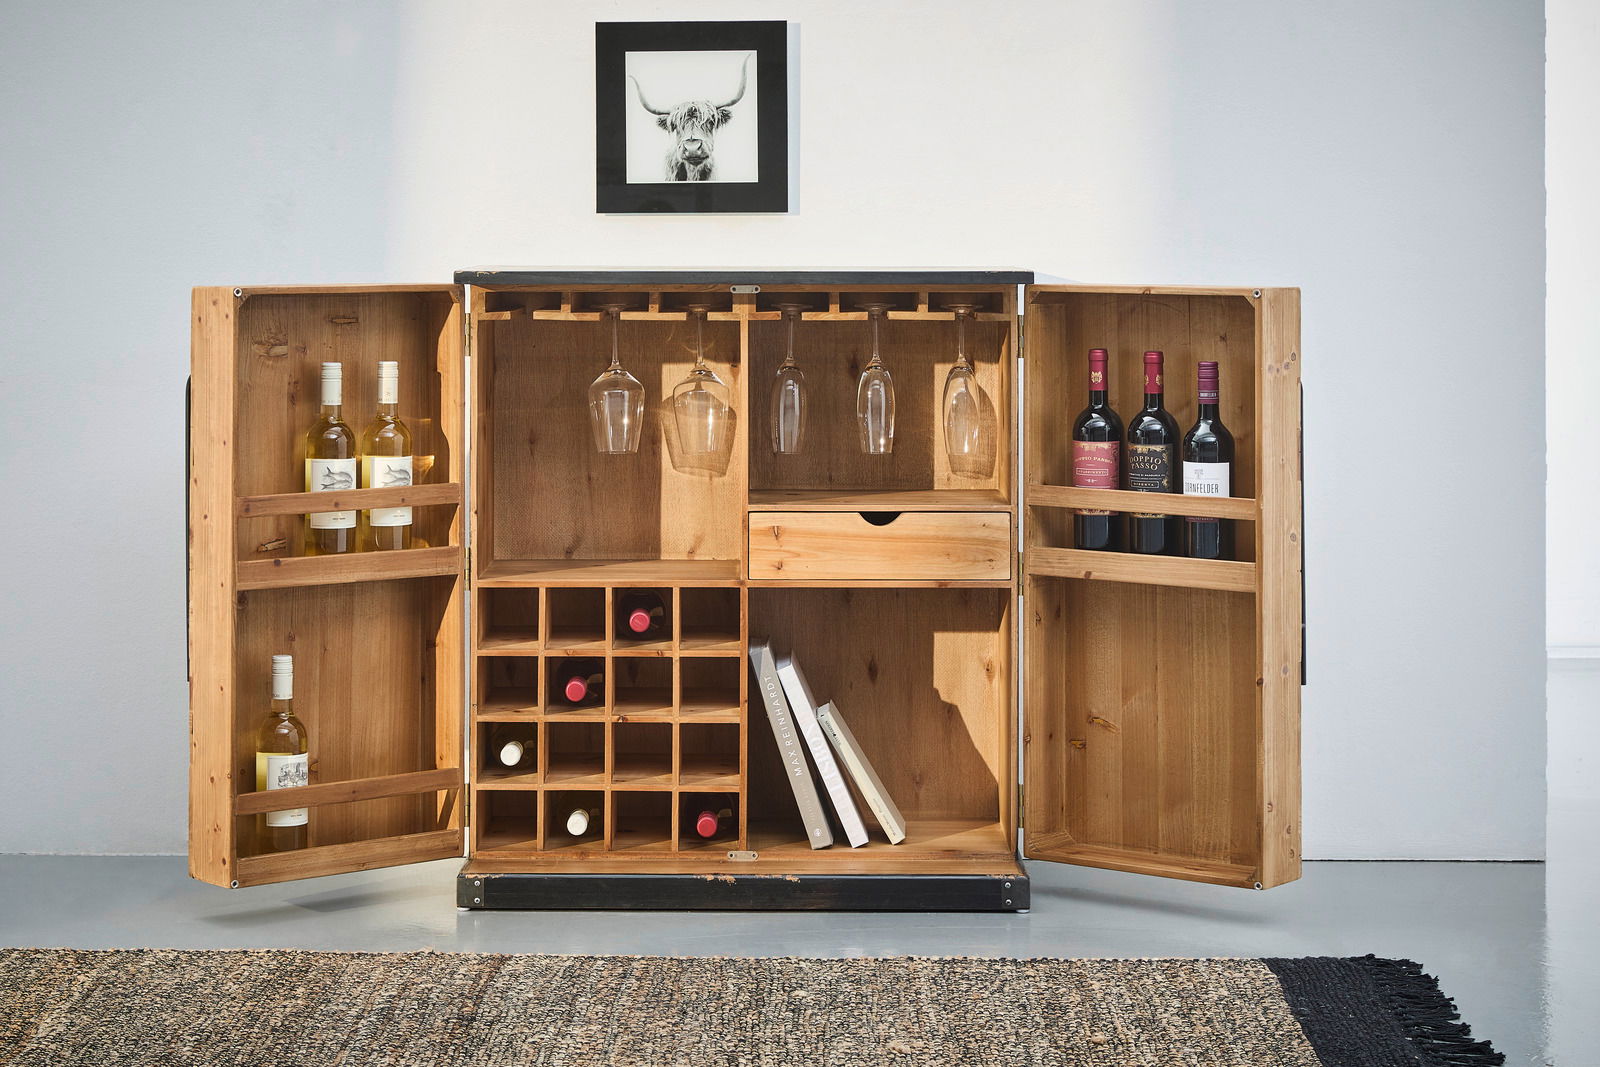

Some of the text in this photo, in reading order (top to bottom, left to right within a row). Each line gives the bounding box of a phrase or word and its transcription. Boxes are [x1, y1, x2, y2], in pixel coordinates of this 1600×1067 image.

[1130, 455, 1162, 465] DOPPIO
[1131, 462, 1158, 471] PASSO
[764, 676, 803, 777] MAX REINHARDT
